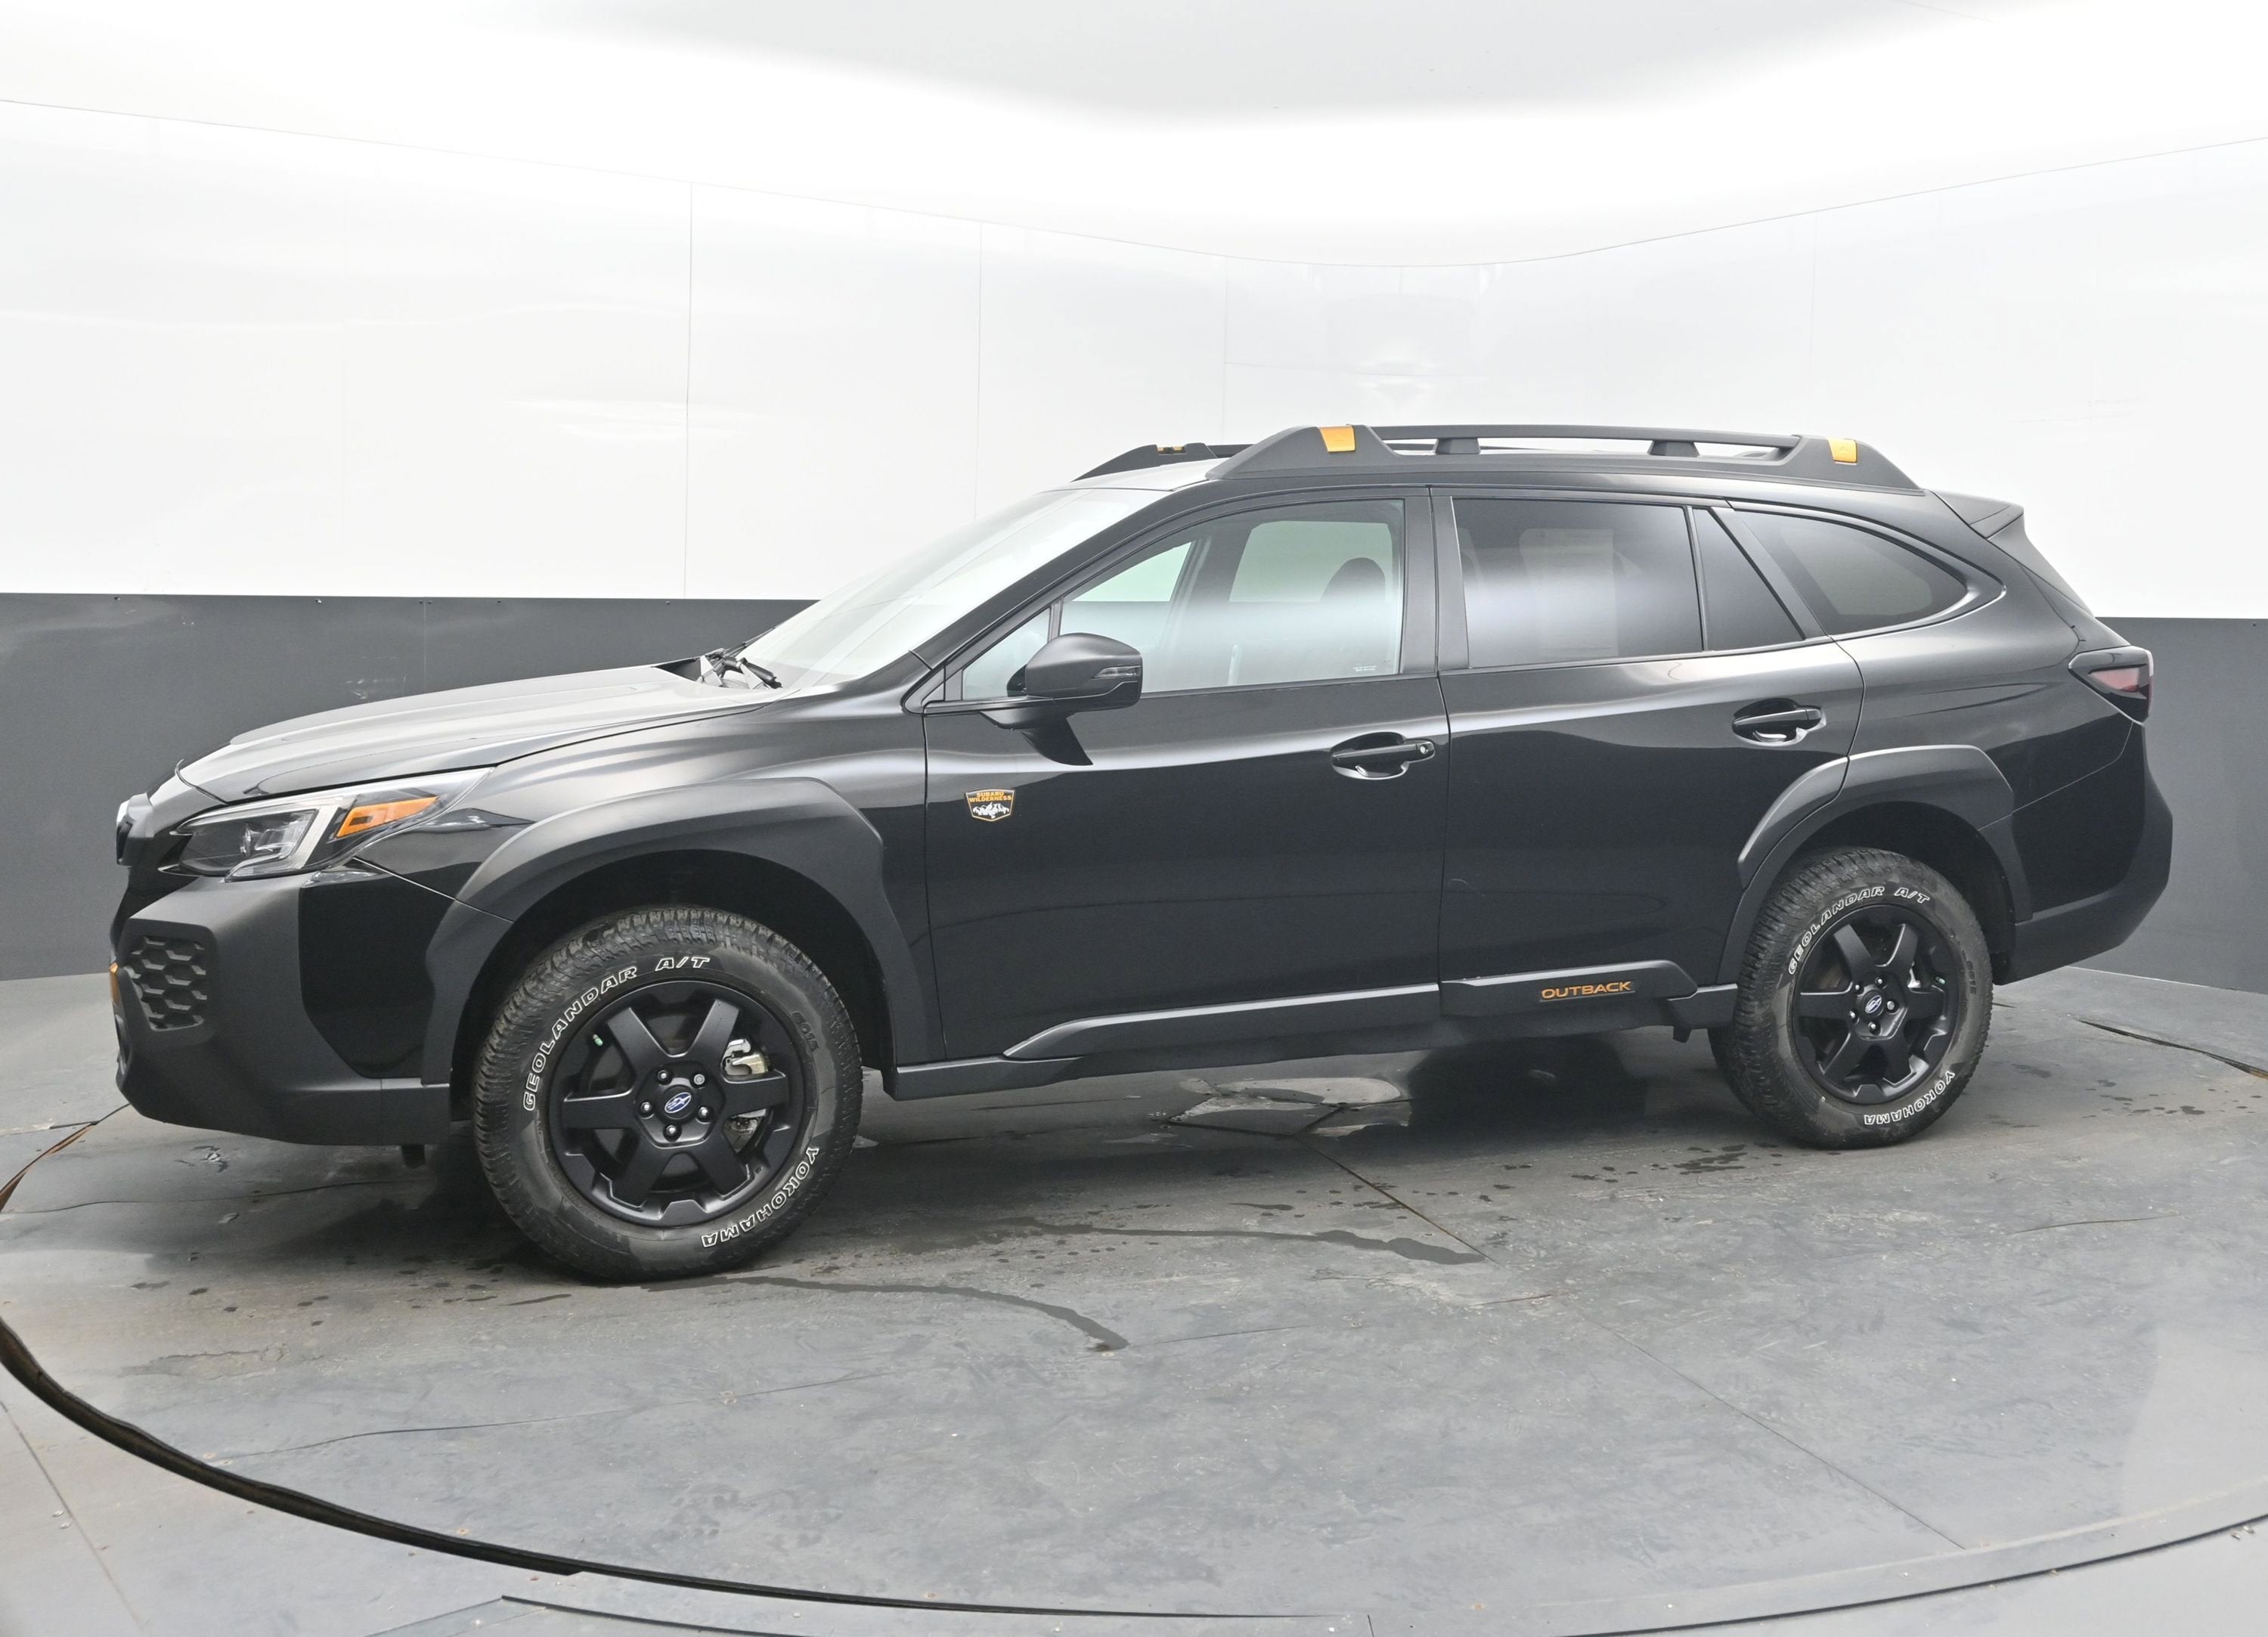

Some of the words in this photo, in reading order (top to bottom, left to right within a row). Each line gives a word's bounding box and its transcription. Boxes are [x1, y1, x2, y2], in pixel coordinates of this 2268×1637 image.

[1788, 885, 1885, 975] GEOLANDAR
[1893, 886, 1930, 904] A/T
[522, 966, 637, 1112] GEOLANDAR
[655, 956, 710, 972] A/T
[1541, 981, 1631, 999] OUTBACK
[1864, 1070, 1955, 1126] YOKOHAMA
[701, 1146, 820, 1248] YOKOHAMA
